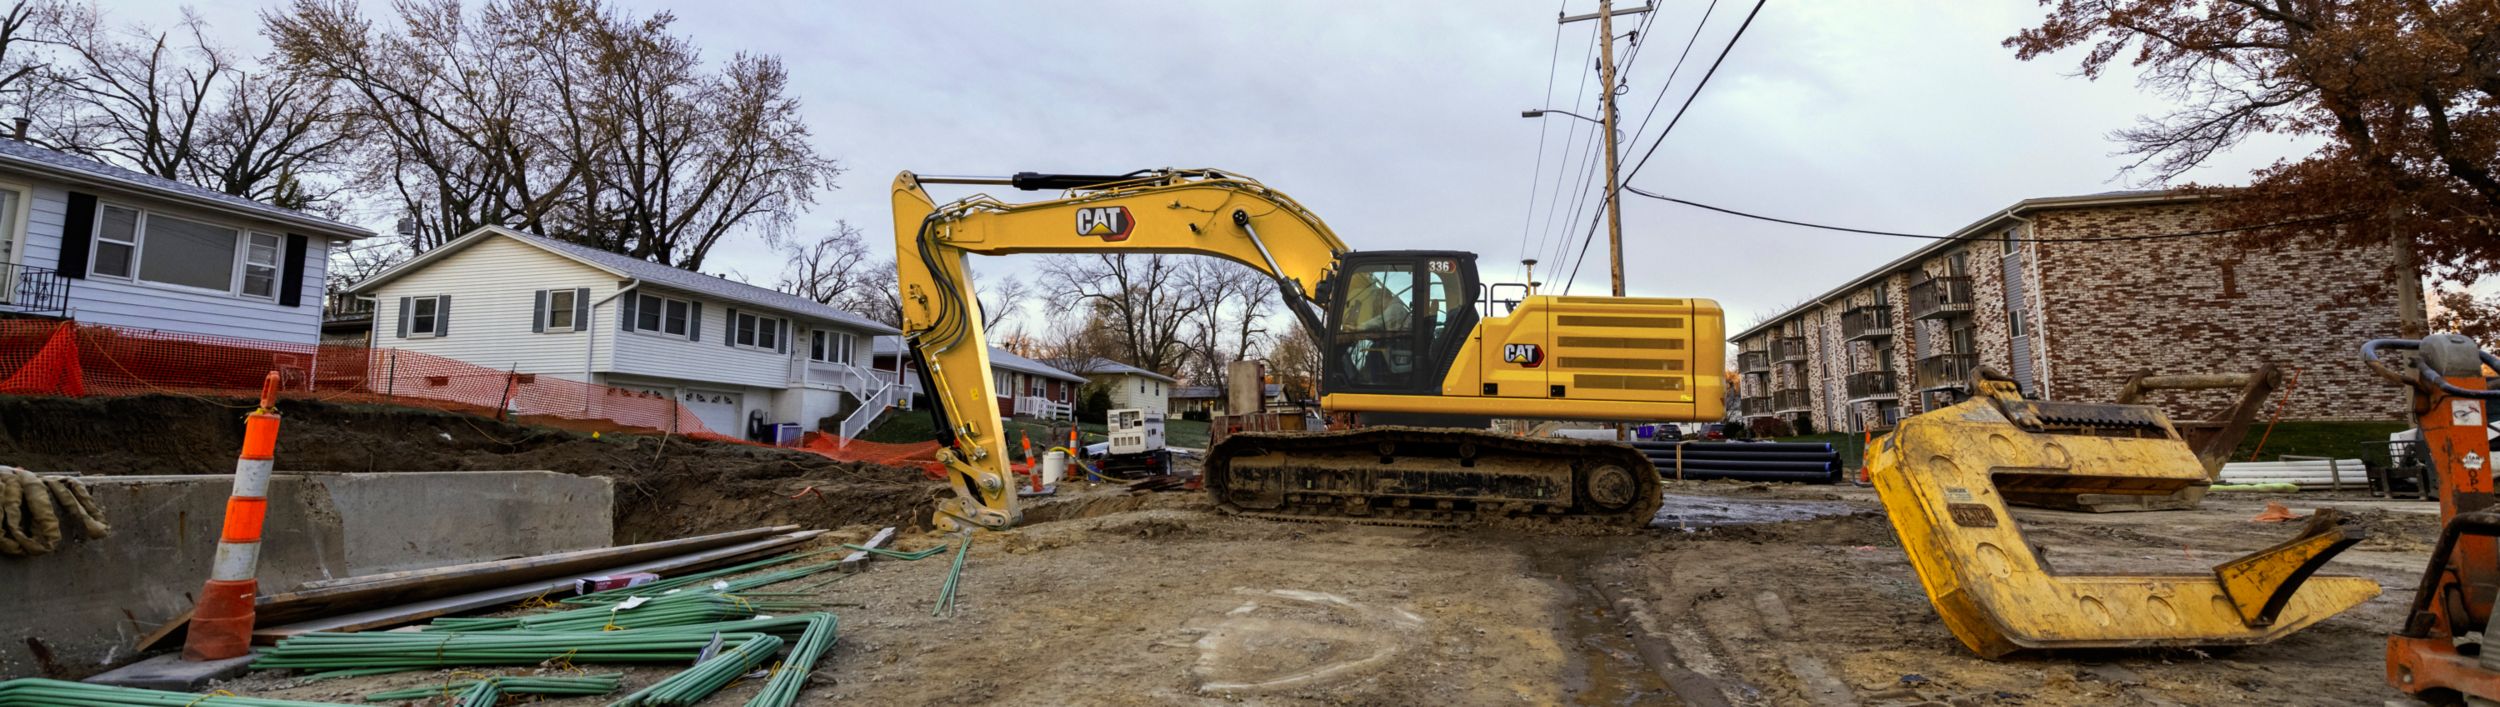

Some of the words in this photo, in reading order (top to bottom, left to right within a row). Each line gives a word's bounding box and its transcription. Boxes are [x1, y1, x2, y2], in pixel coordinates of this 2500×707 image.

[1077, 207, 1120, 235] CAT
[1428, 261, 1449, 271] 336
[1505, 344, 1535, 362] CAT
